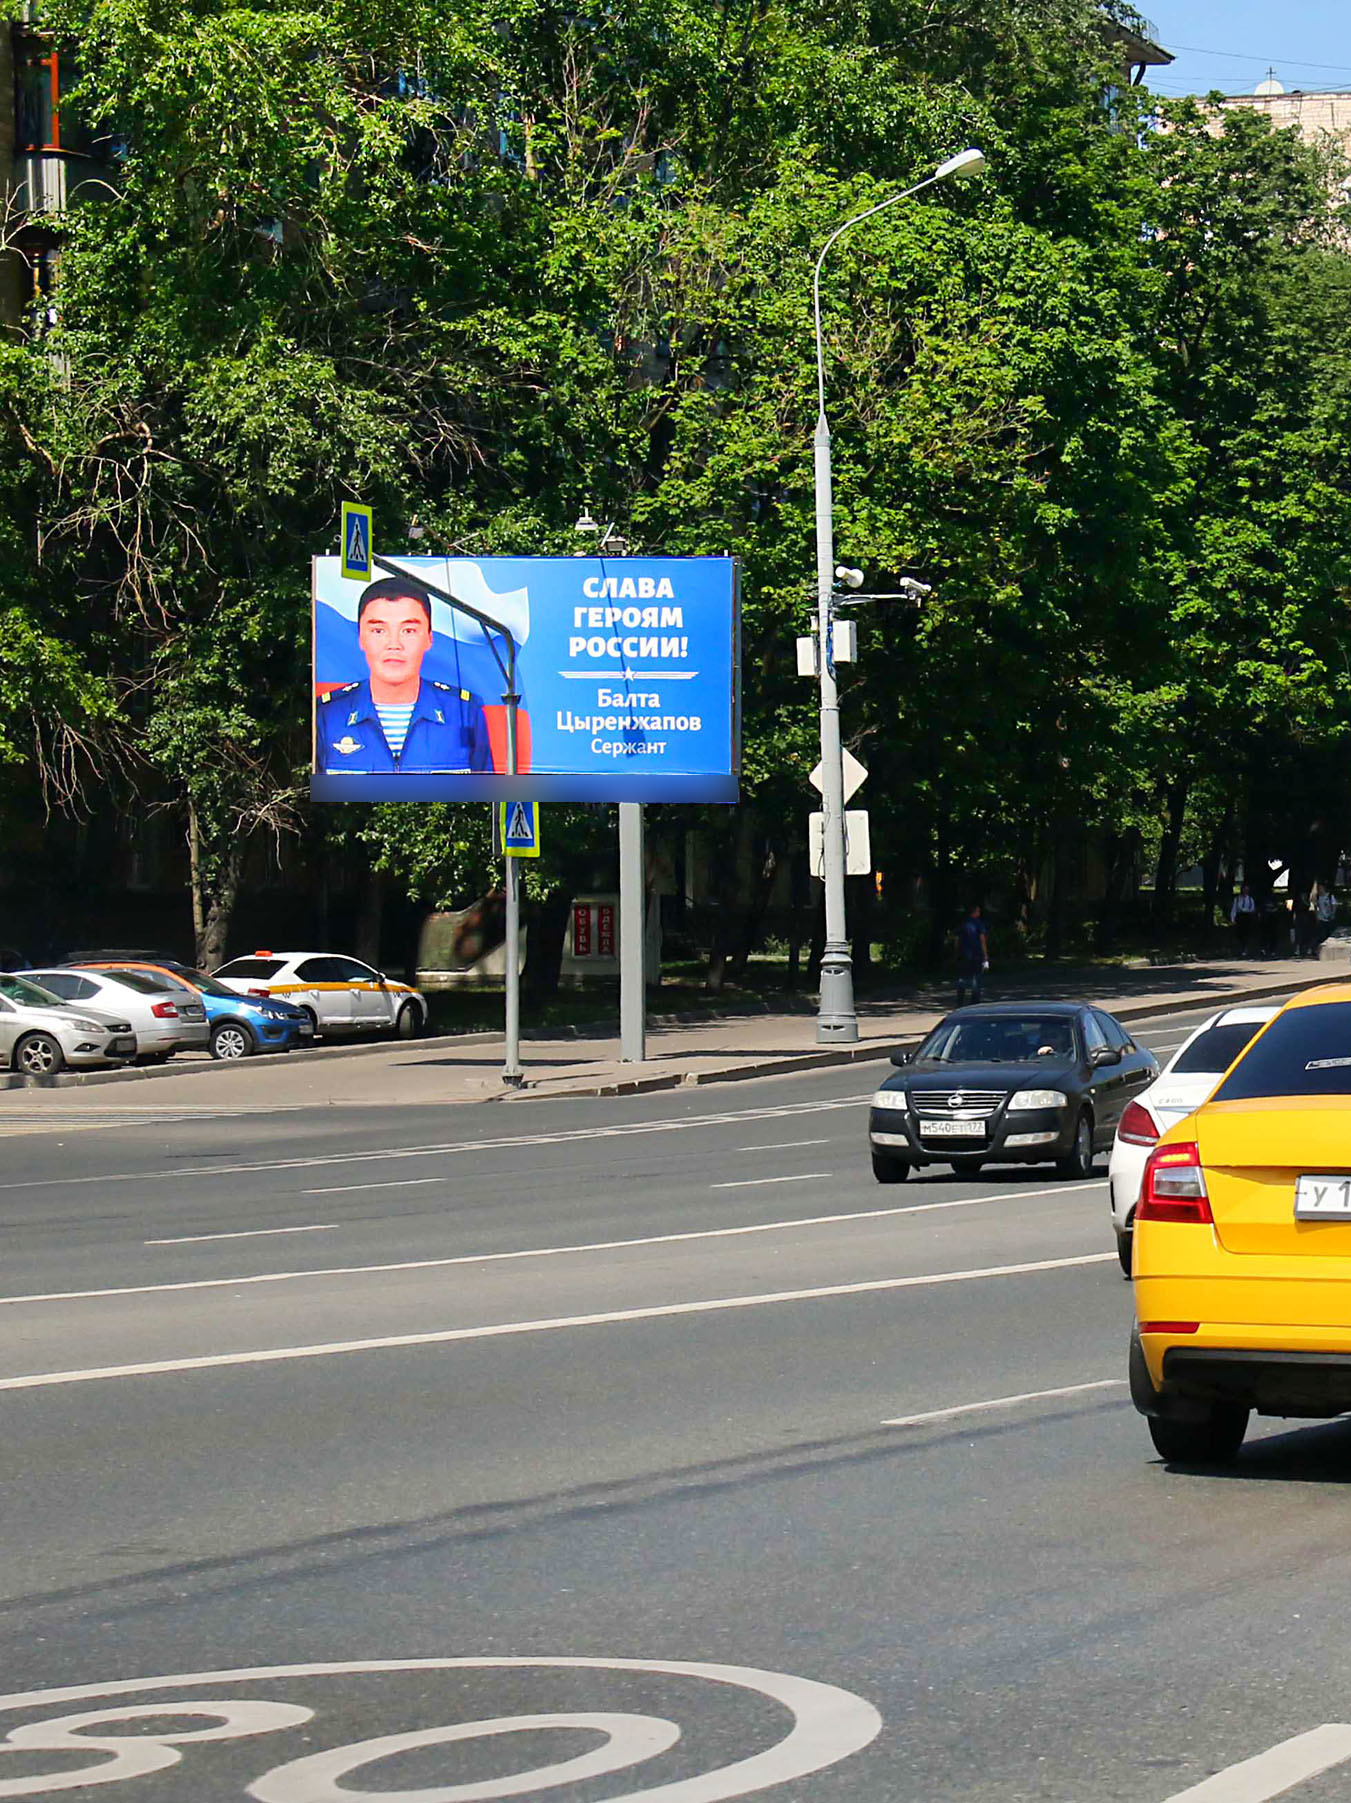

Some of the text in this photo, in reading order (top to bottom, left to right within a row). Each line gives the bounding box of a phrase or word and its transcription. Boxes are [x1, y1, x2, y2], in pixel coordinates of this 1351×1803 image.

[583, 577, 674, 599] СЛАВА
[574, 607, 683, 628] ГЕРОЯМ
[569, 637, 689, 658] РОССИИ!
[597, 689, 661, 708] Балта
[556, 711, 702, 734] Цыренжапов
[591, 738, 667, 757] Сержант
